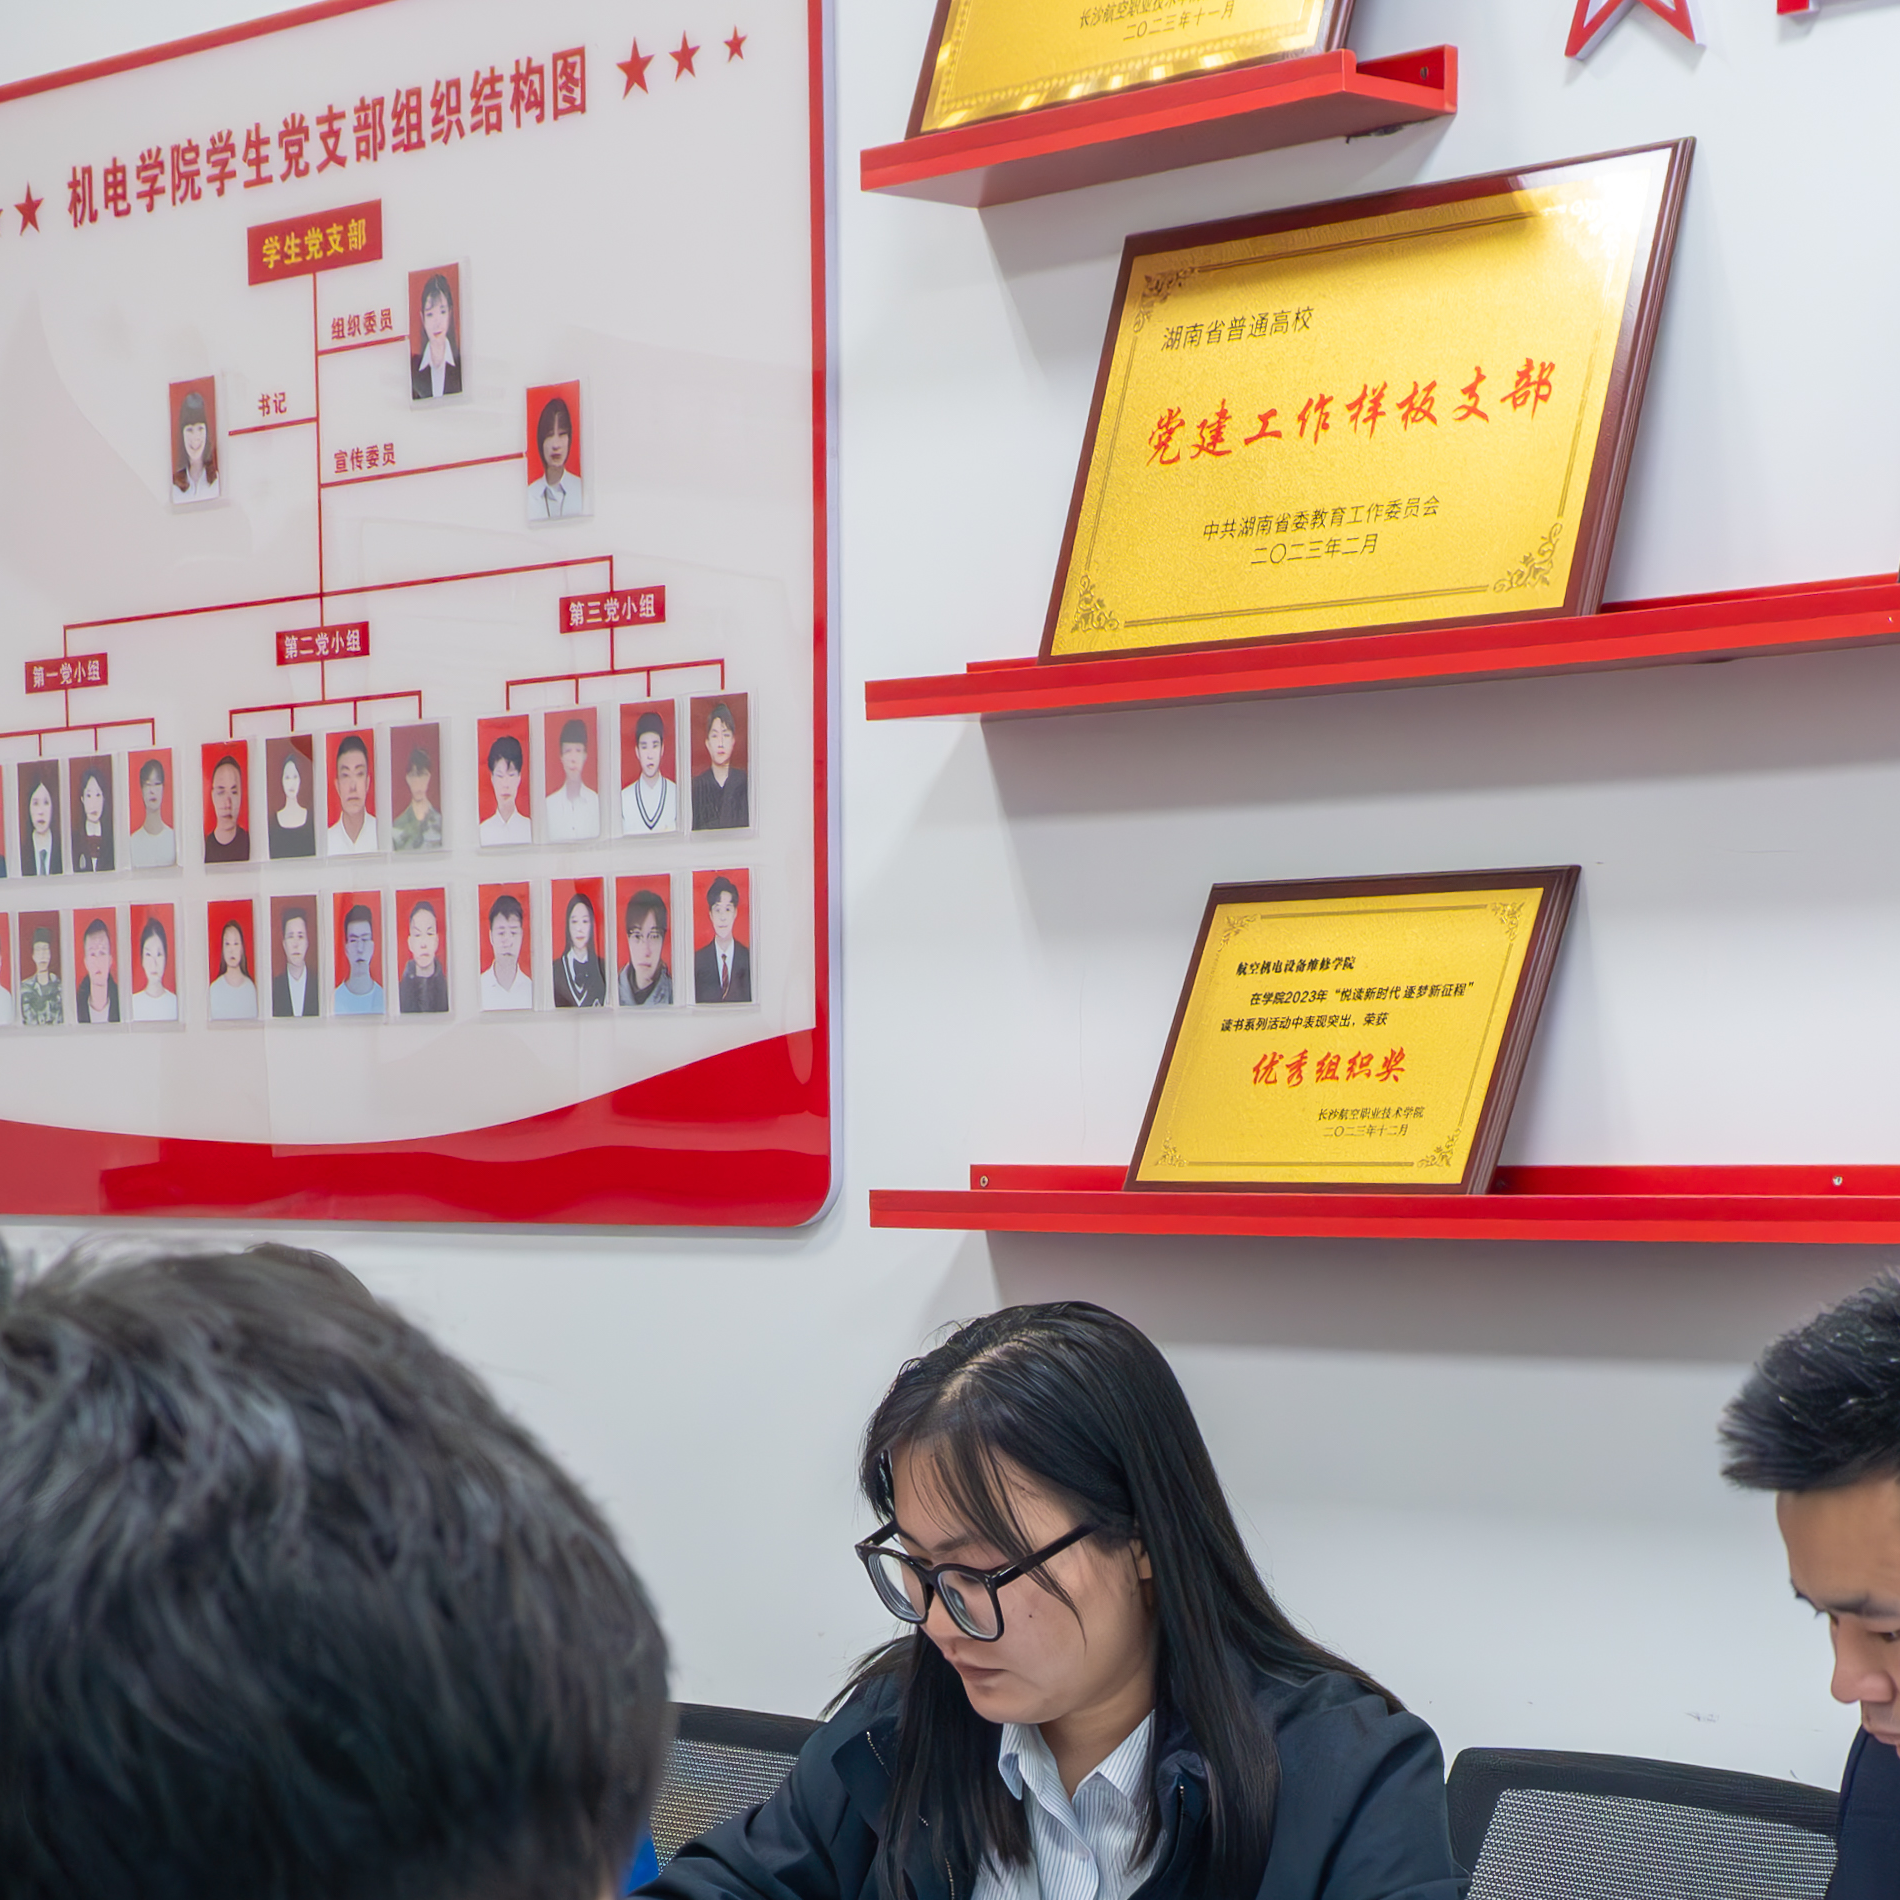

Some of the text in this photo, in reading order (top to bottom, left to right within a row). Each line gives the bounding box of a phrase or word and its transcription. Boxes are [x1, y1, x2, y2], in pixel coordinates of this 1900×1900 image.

[1080, 0, 1205, 29] 长沙航空职业技
[67, 45, 589, 229] 机电学院学生党支部组织结构图
[261, 217, 369, 269] 学生党支部
[330, 308, 393, 342] 组织委员
[1161, 306, 1315, 352] 湖南省普通高校
[257, 391, 287, 417] 书记
[1144, 358, 1557, 468] 党建工作样板支部
[333, 441, 397, 473] 宣传委员
[1202, 496, 1441, 542] 中共湖南省委教育工作委员会
[568, 592, 657, 629] 第三党小组
[283, 628, 362, 660] 第二党小组
[32, 658, 102, 689] 第一党小组
[1236, 956, 1357, 977] 航空机电设备维修学院
[1252, 1047, 1407, 1088] 优秀组织奖
[1317, 1106, 1425, 1121] 长沙航空职业技术学院
